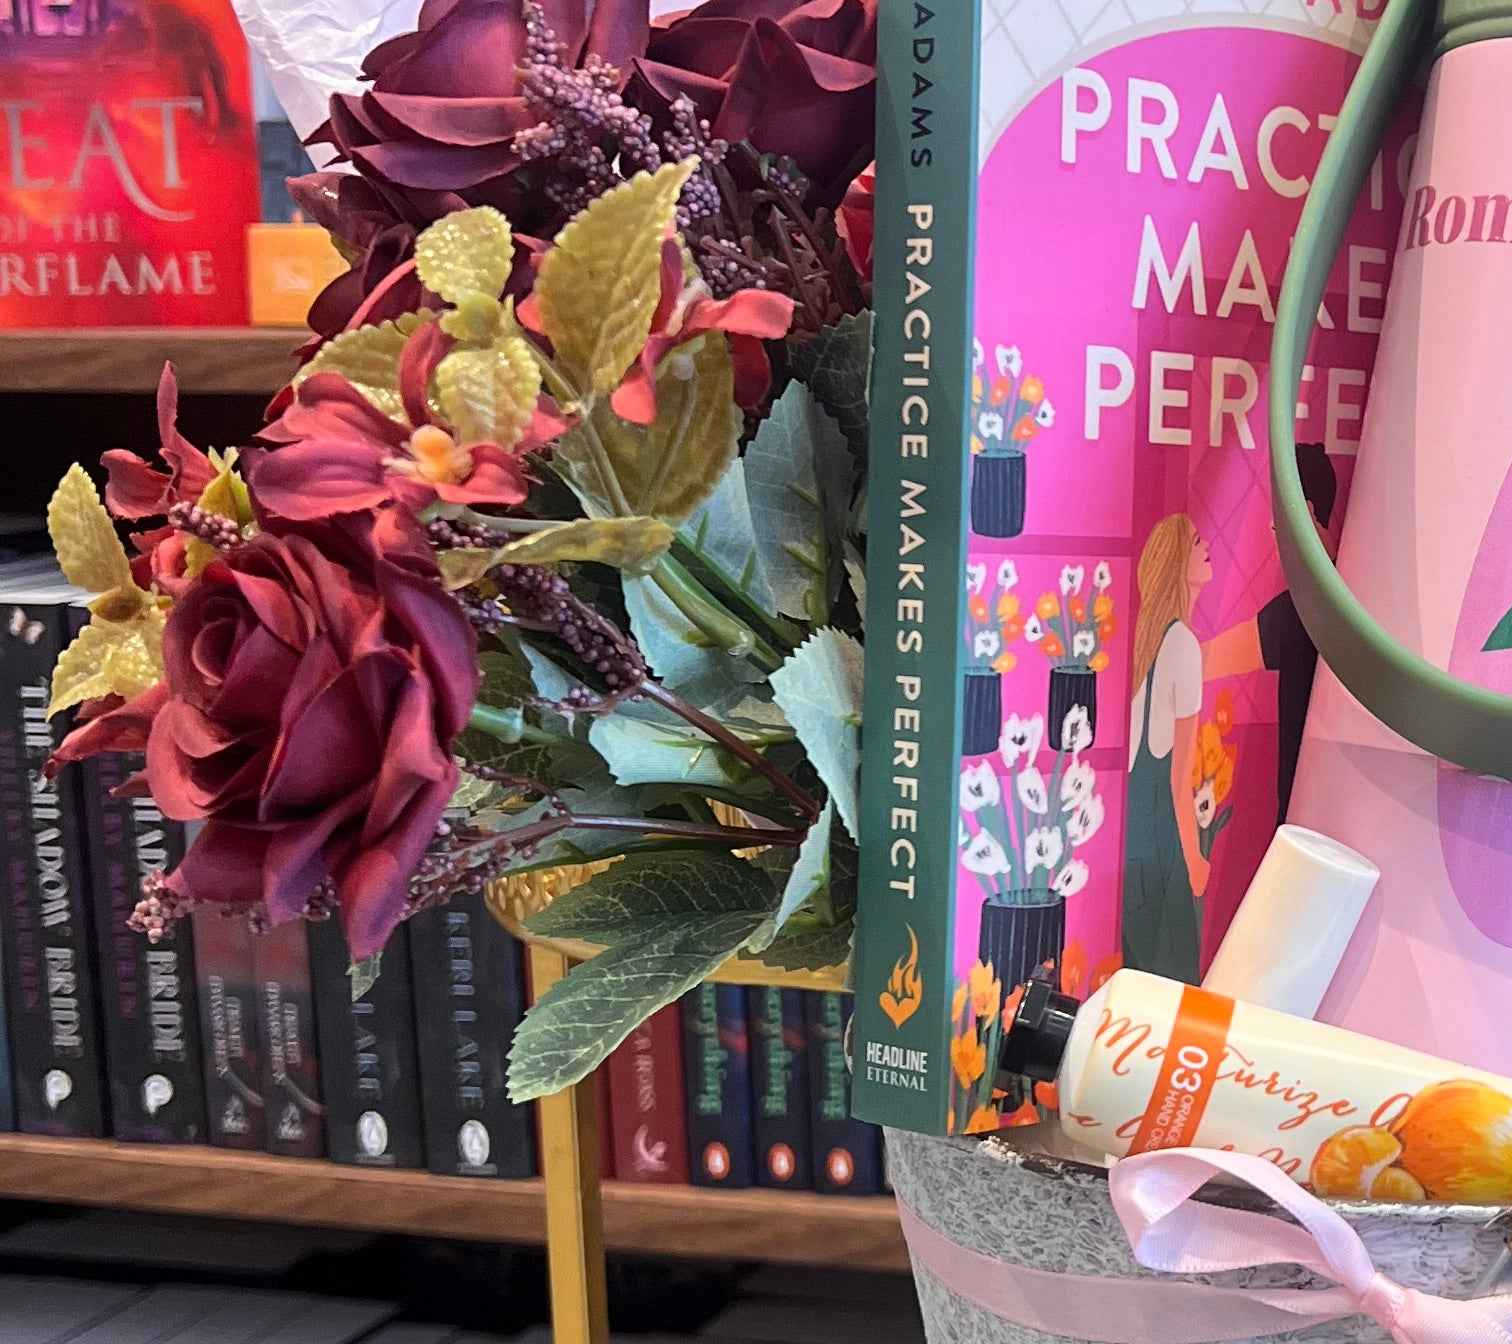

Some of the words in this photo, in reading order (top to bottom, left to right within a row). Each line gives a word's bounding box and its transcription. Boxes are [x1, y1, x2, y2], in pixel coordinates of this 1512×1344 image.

[908, 2, 936, 170] ADAMS
[52, 212, 121, 243] THE
[900, 203, 935, 460] PRACTICE
[895, 479, 928, 655] MAKES
[888, 674, 922, 902] PERFECT
[45, 947, 82, 1057] BRIDE
[146, 950, 187, 1062] BRIDE
[453, 1010, 485, 1110] LAKE
[866, 1041, 928, 1073] HEADLINE
[866, 1066, 928, 1092] ETERNAL
[1170, 1045, 1209, 1093] 03
[1155, 1090, 1179, 1127] HAND
[1163, 1094, 1195, 1147] ORANGE
